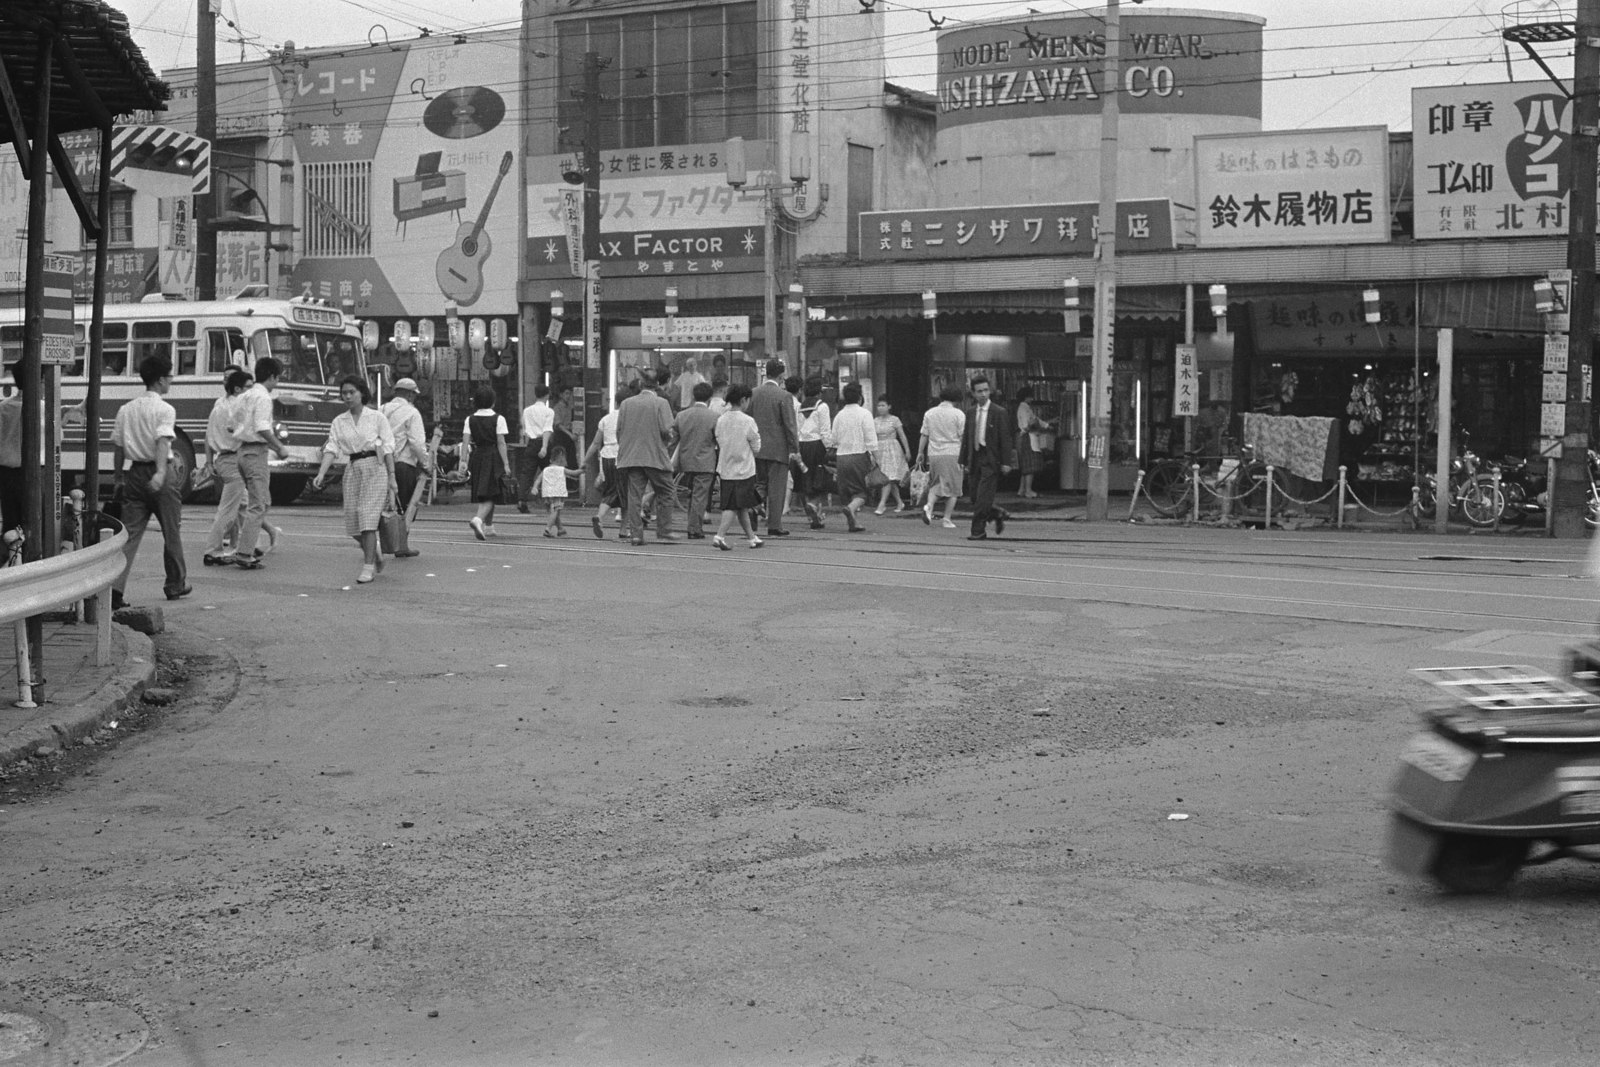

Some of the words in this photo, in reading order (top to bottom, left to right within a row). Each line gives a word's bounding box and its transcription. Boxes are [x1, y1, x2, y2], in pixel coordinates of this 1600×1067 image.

[953, 41, 1009, 68] MODE
[1130, 33, 1202, 58] WEAR
[298, 68, 376, 96] レコード
[1125, 65, 1184, 98] CO.
[1428, 100, 1494, 135] 印章
[1524, 99, 1563, 193] ハンコ
[1427, 160, 1494, 195] ゴム印
[1208, 189, 1373, 229] 鈴木履物店
[1496, 202, 1567, 230] 北村
[633, 233, 723, 256] FACTOR
[637, 259, 724, 274] やまとや
[45, 348, 71, 360] CROSSING
